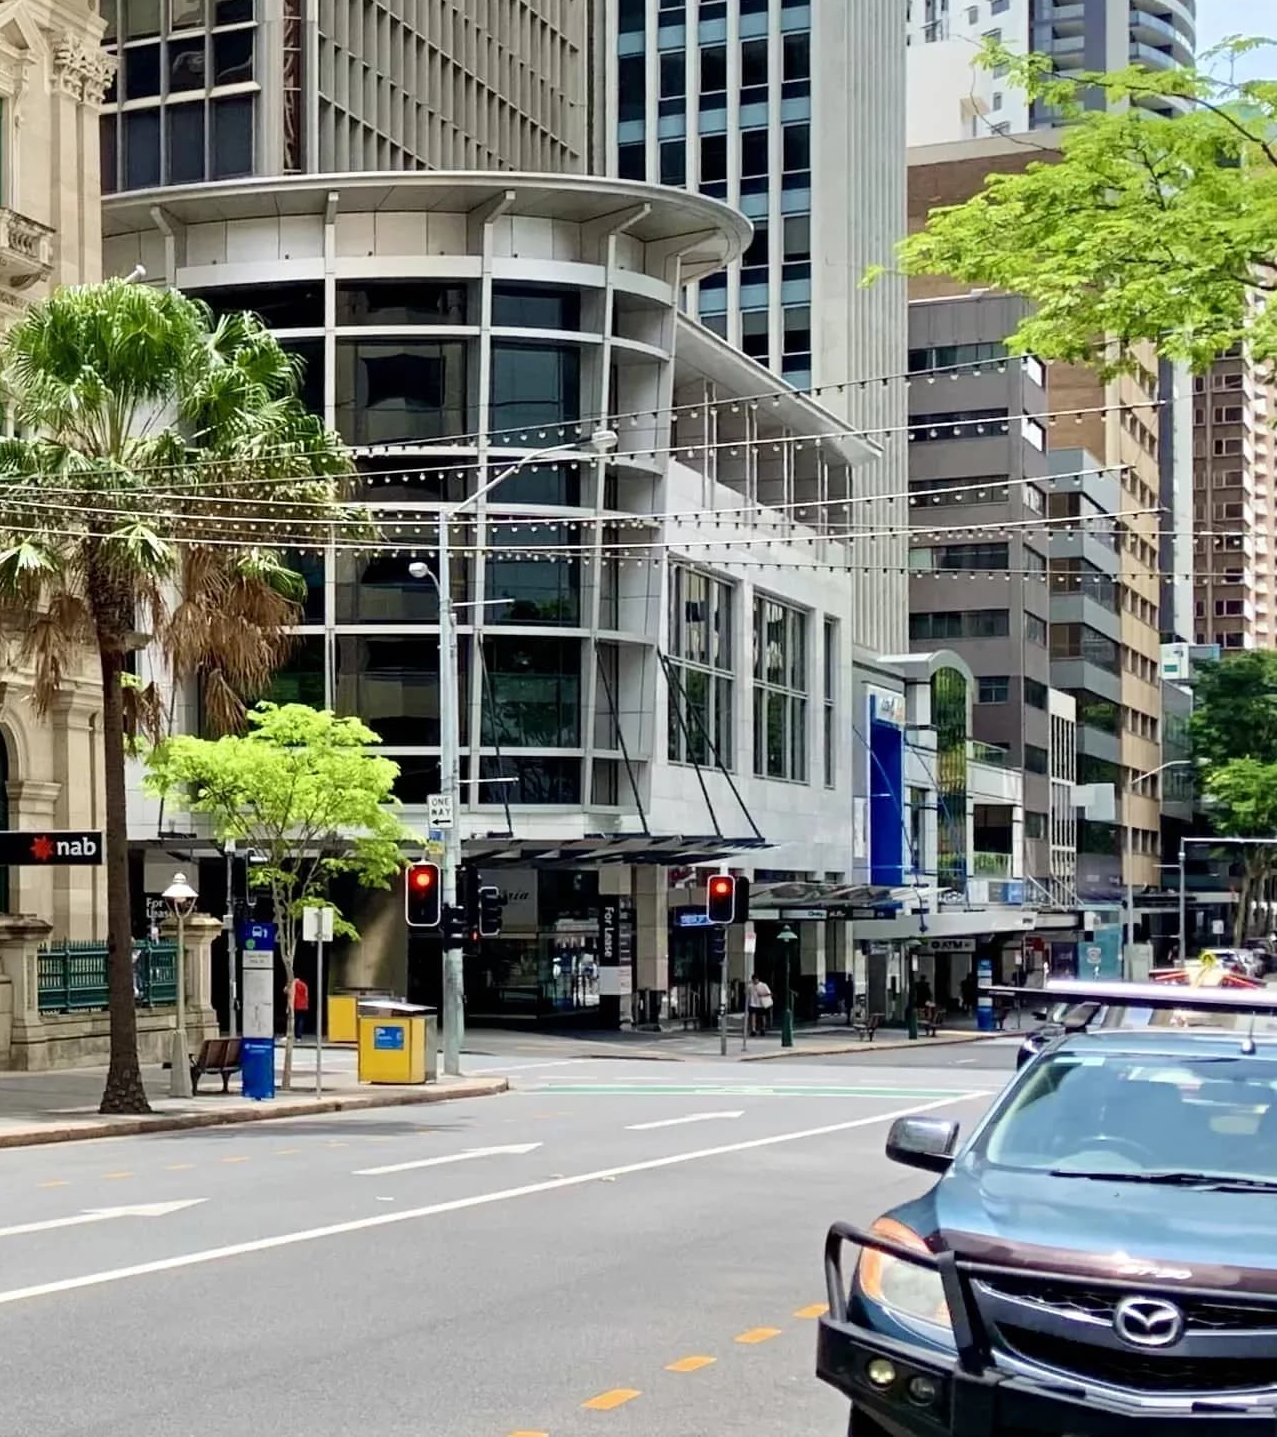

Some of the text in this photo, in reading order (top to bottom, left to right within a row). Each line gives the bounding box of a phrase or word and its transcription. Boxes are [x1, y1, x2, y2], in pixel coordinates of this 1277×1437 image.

[432, 798, 449, 806] ONE
[432, 808, 450, 816] WAY
[57, 836, 97, 856] nab
[146, 897, 163, 908] For
[604, 906, 614, 958] For Lease
